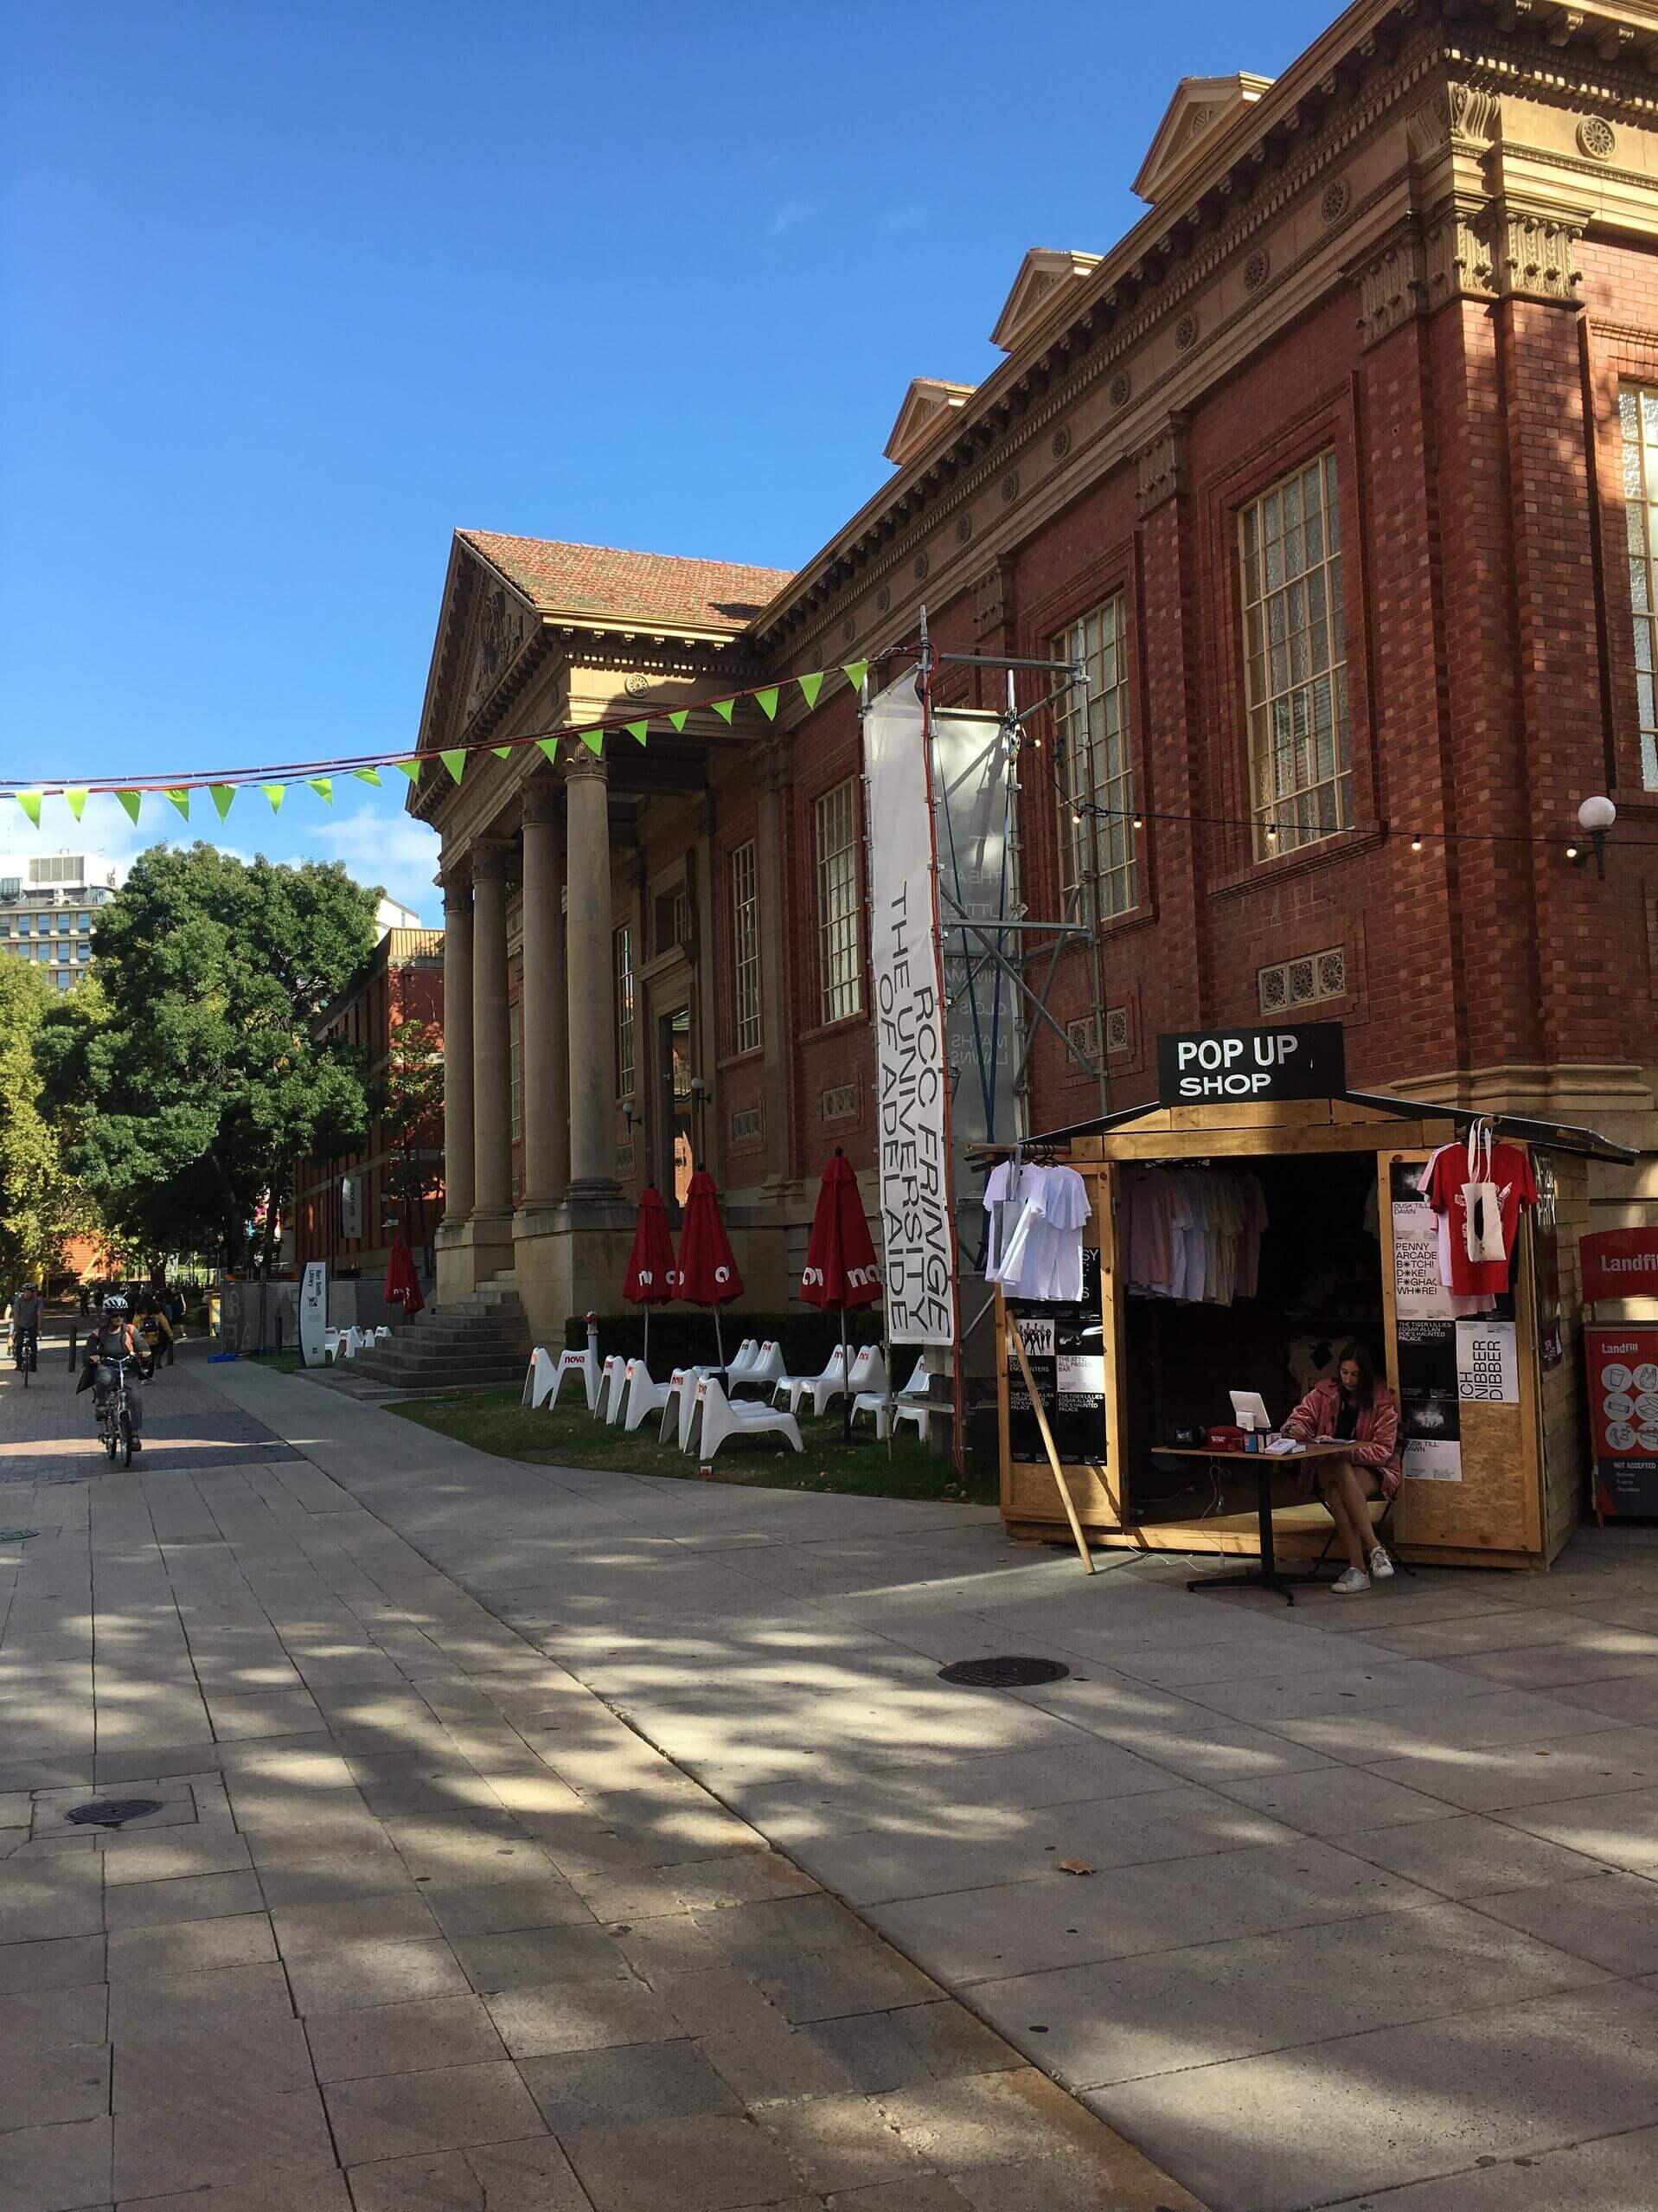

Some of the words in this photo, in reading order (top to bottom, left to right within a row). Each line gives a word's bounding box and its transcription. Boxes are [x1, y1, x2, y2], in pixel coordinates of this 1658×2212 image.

[892, 881, 910, 994] THE
[880, 973, 898, 1051] OF
[913, 985, 938, 1108] RCC
[1177, 1039, 1244, 1070] POP
[1254, 1035, 1298, 1066] UP
[1179, 1073, 1271, 1096] SHOP
[882, 1062, 909, 1330] ADELAIDE
[897, 1005, 929, 1332] UNIVERSITY
[918, 1123, 951, 1338] FRINGE
[1473, 1340, 1488, 1401] NIBBER
[1488, 1340, 1503, 1401] DIBBER
[1602, 1343, 1638, 1354] Landfill
[1459, 1371, 1475, 1400] ICH
